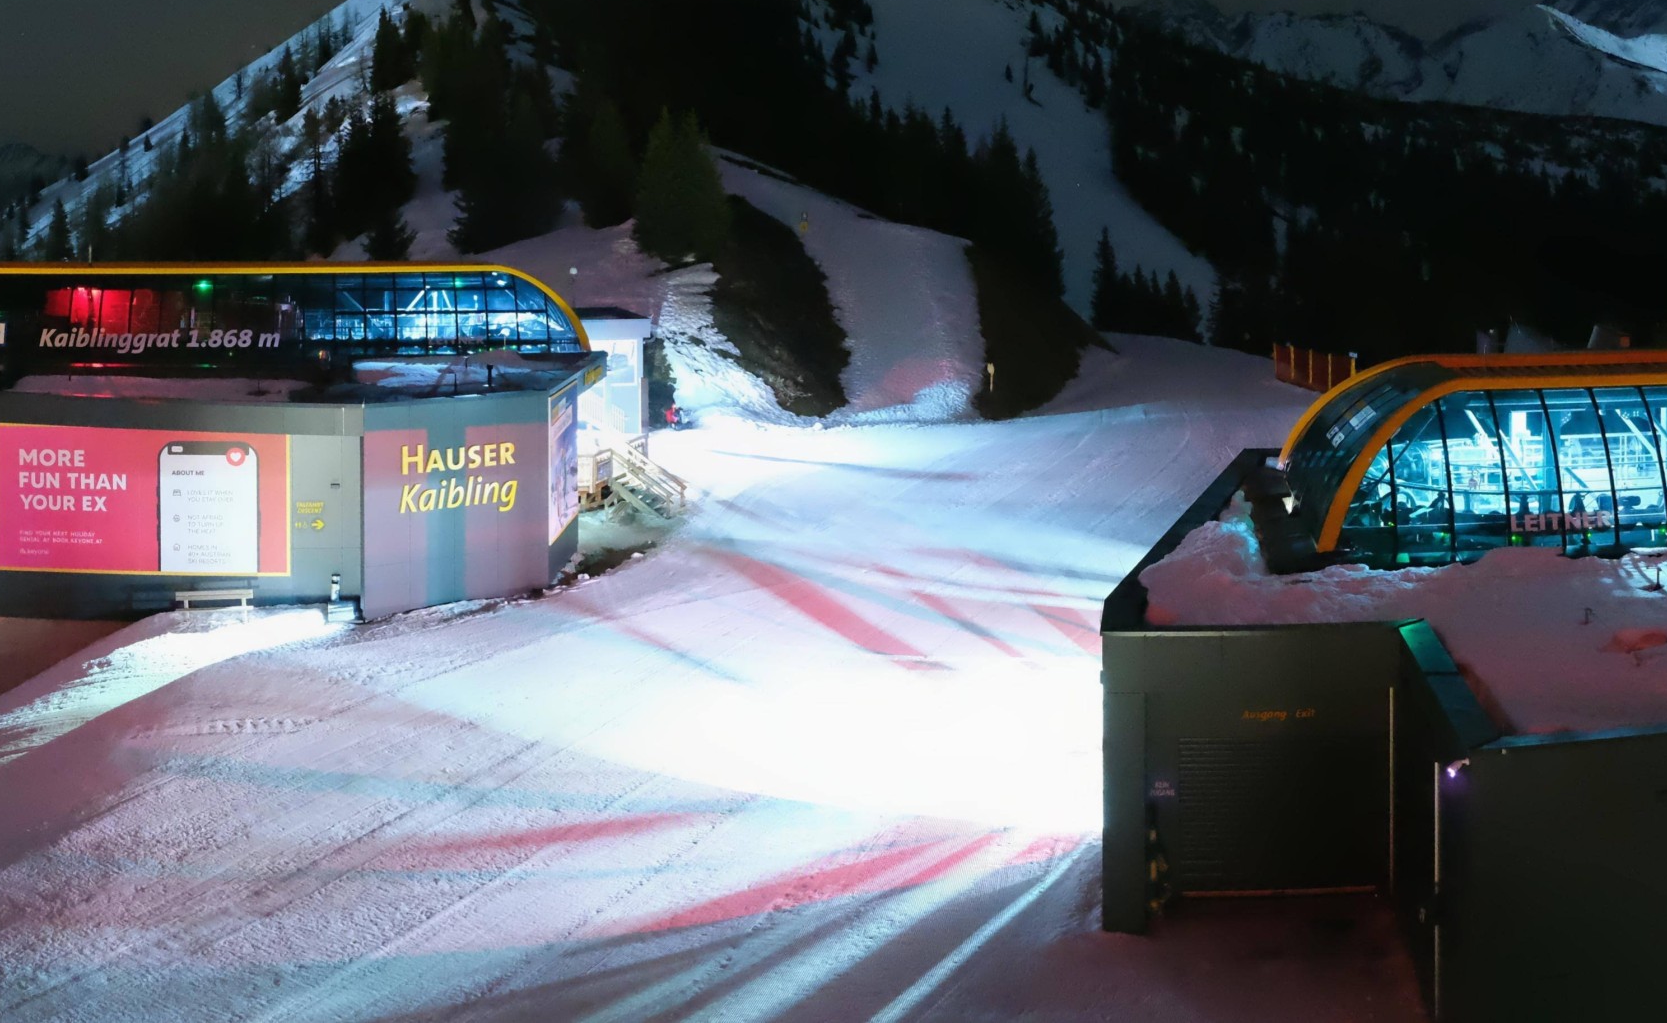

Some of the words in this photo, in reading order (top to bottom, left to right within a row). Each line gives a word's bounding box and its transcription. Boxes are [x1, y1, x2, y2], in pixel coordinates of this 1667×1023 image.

[39, 328, 181, 354] Kaiblinggrat
[186, 329, 252, 348] 1.868
[258, 333, 280, 348] m
[18, 448, 85, 467] MORE
[401, 442, 516, 475] HAUSER
[18, 471, 60, 489] FUN
[67, 473, 127, 490] THAN
[20, 494, 75, 511] YOUR
[82, 496, 107, 512] EX
[399, 475, 518, 514] Kaibling
[1510, 511, 1612, 532] LEITNER
